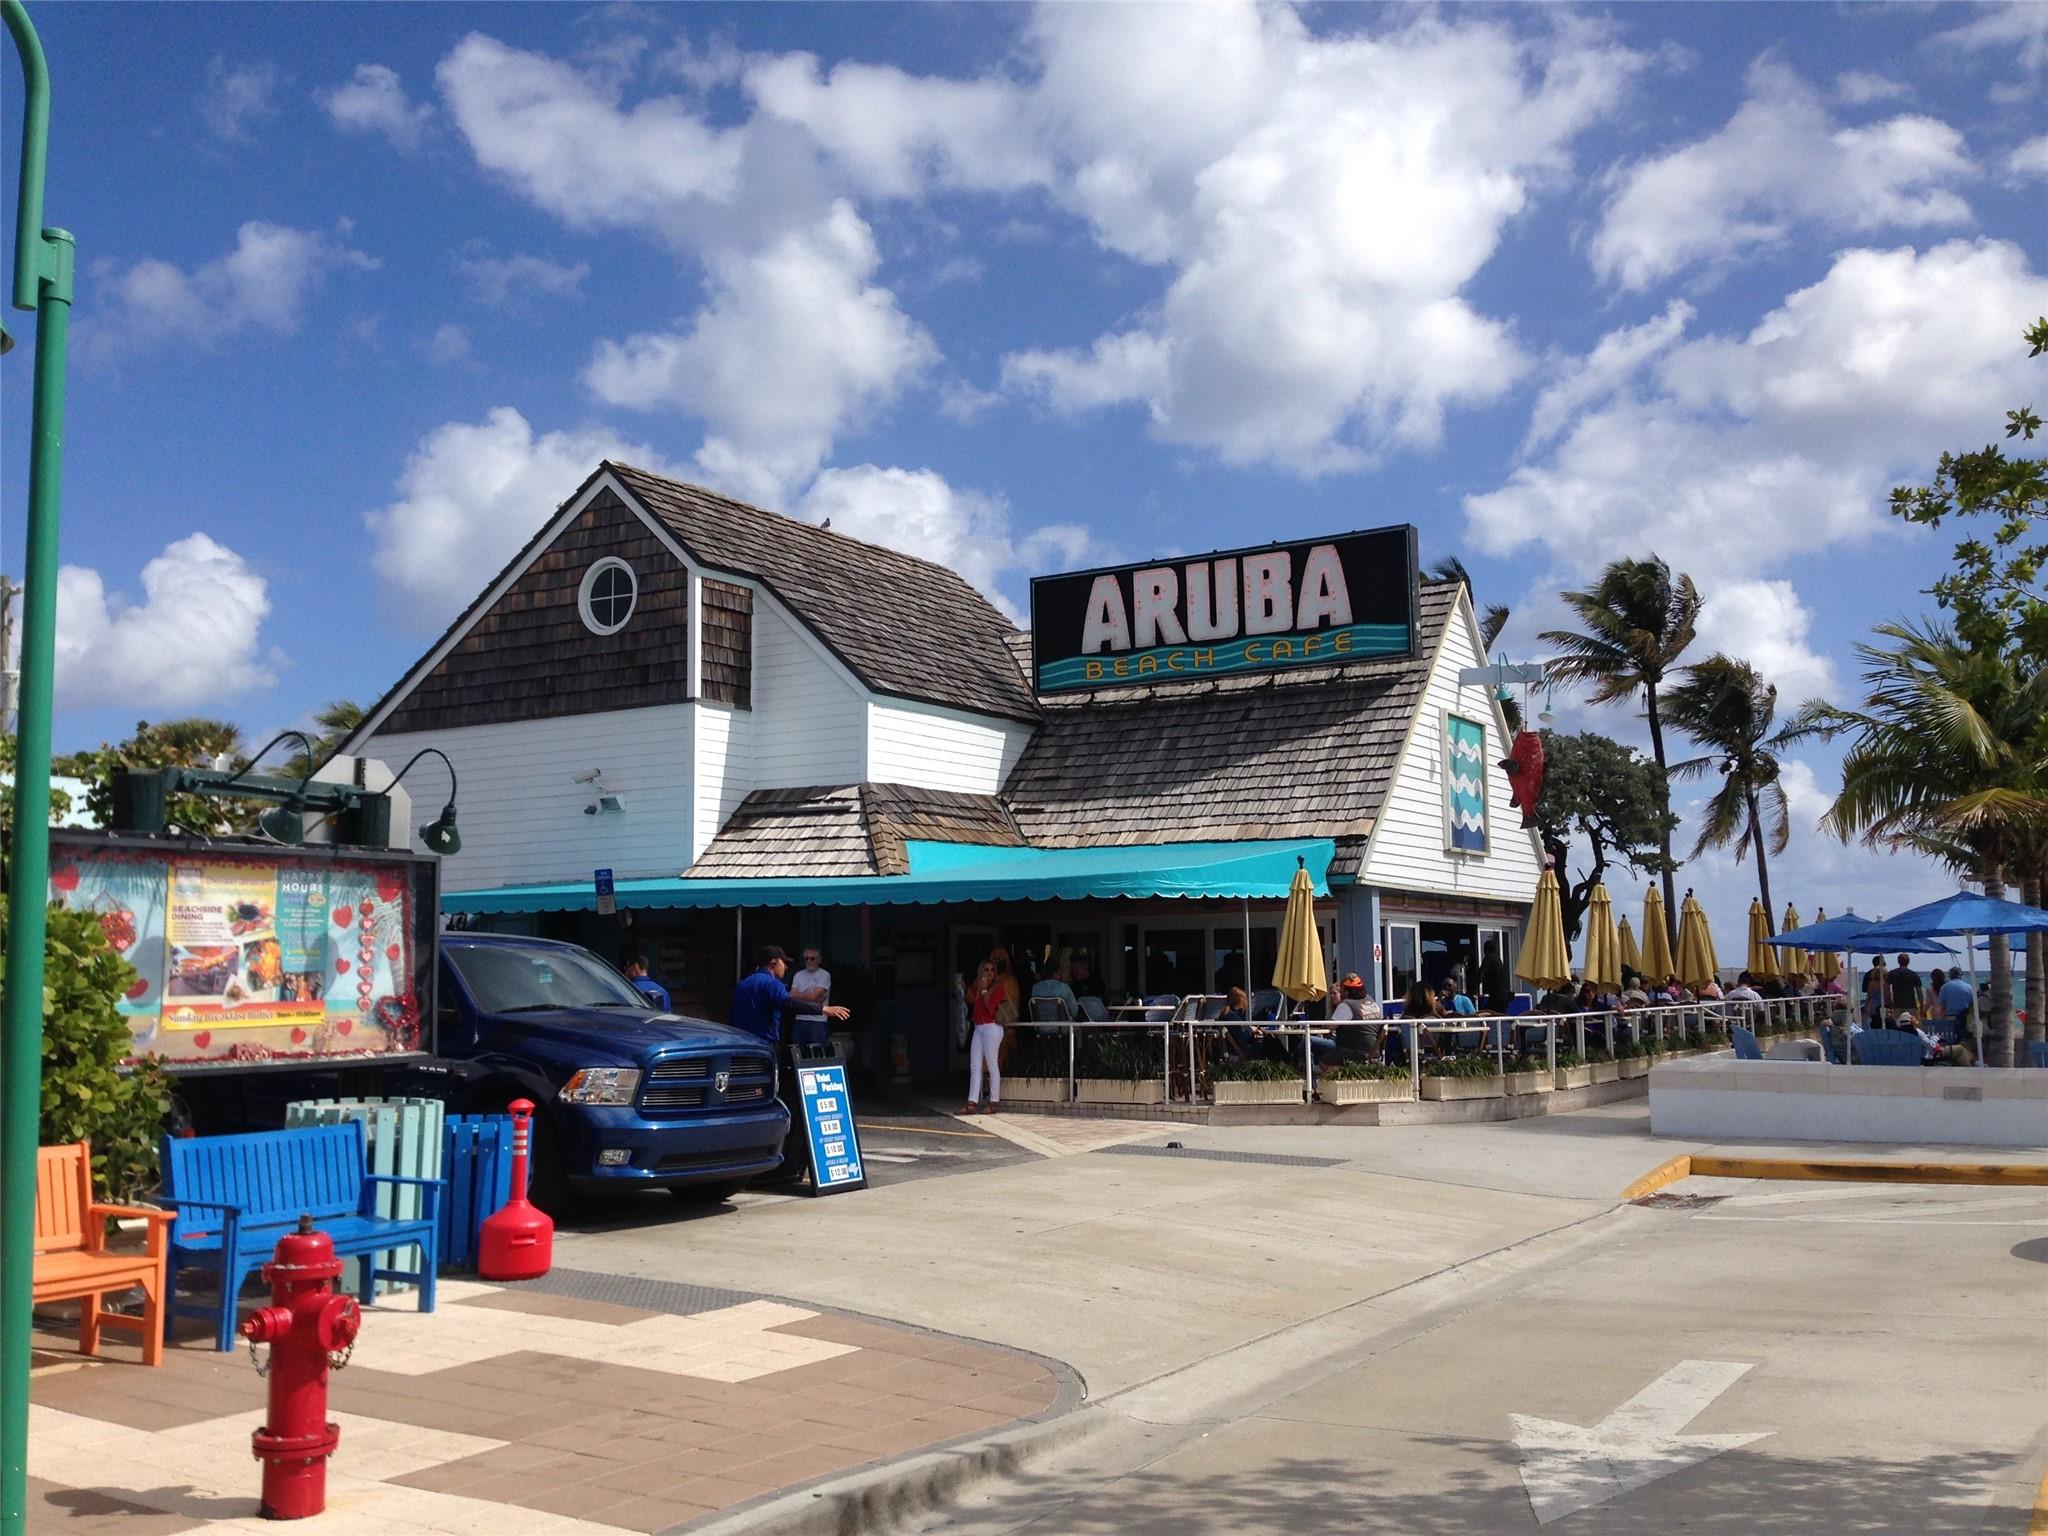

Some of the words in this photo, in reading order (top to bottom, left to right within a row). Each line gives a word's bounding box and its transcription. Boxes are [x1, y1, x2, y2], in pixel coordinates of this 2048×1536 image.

[1081, 544, 1353, 654] ARUBA
[1086, 648, 1214, 680] BEACH
[1244, 632, 1353, 663] CAFE
[282, 871, 324, 881] HAPPY
[171, 905, 223, 913] BEACHSIDE
[168, 1013, 201, 1023] Sunday
[821, 1082, 844, 1093] Parking
